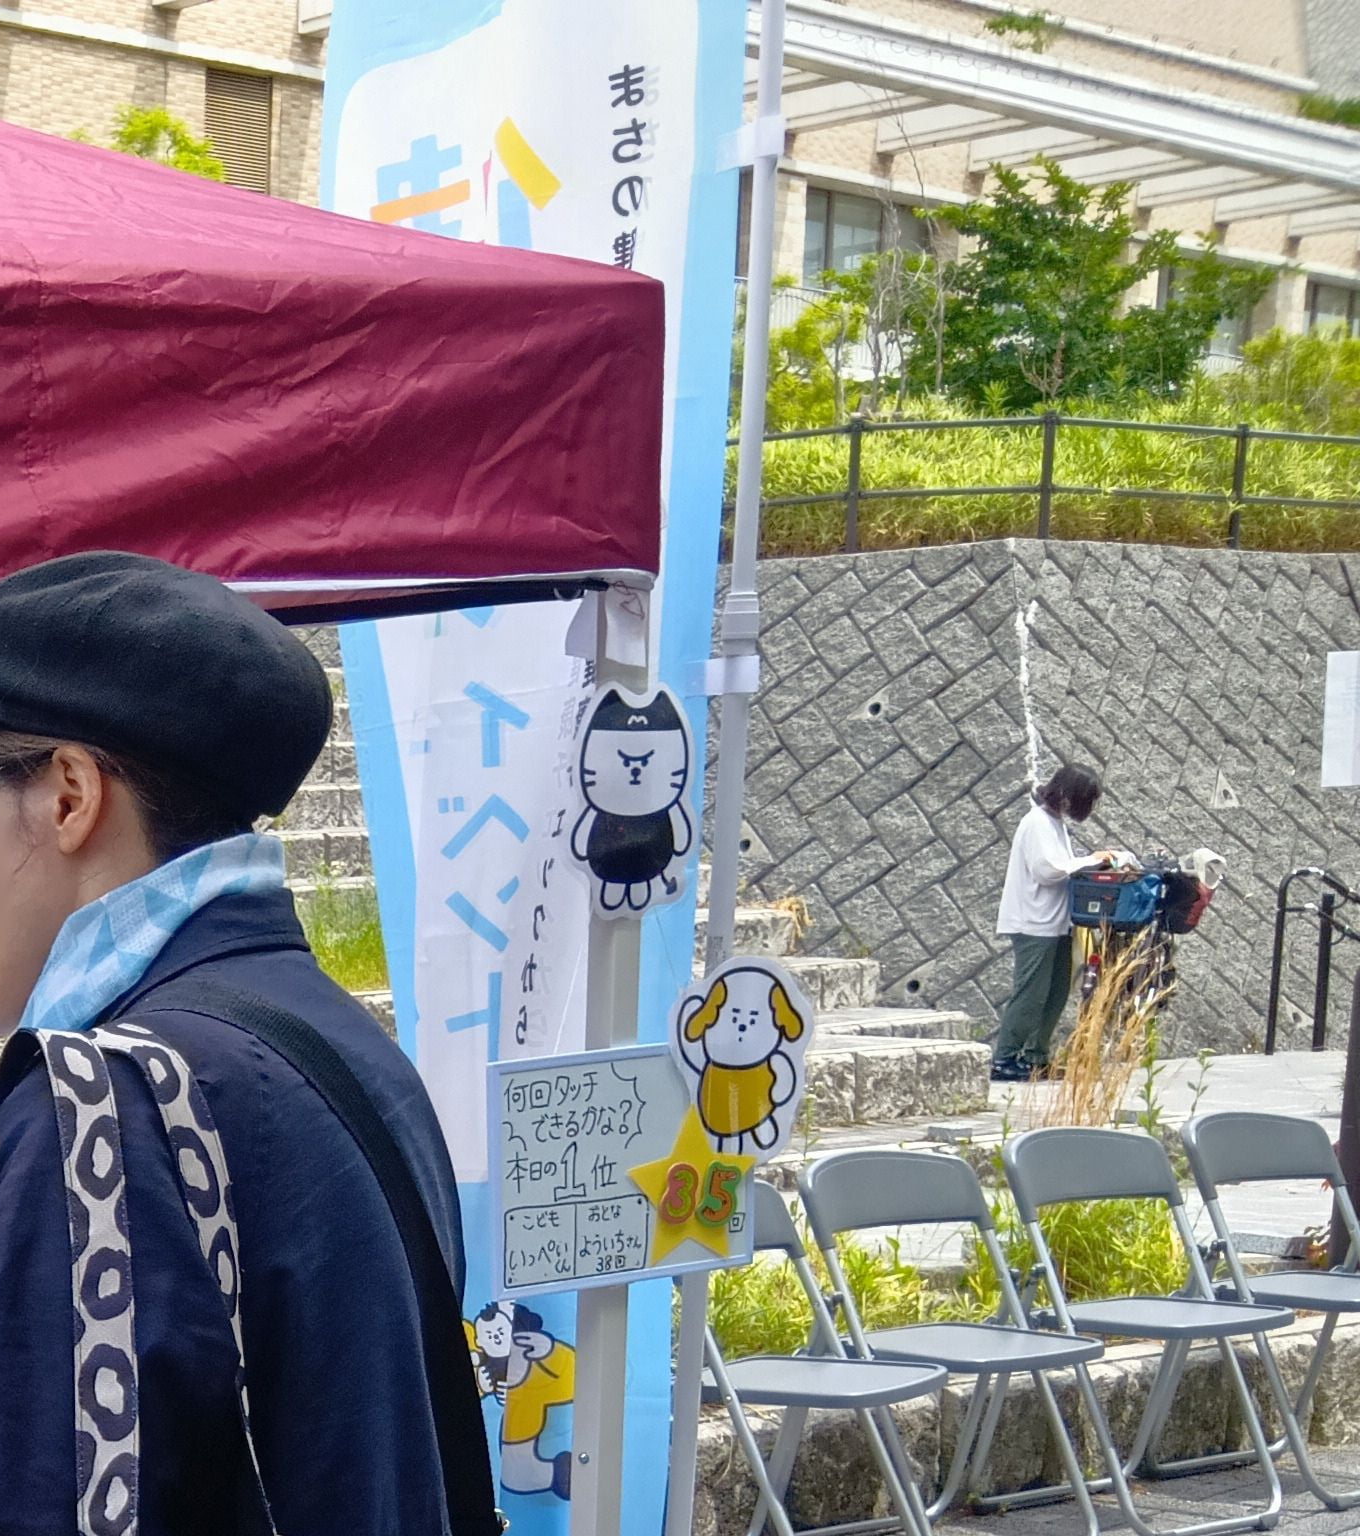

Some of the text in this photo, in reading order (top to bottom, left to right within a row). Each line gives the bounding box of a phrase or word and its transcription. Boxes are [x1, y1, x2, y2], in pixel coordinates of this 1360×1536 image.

[504, 1071, 598, 1113] 何回タッチ
[531, 1099, 633, 1143] できるかな?
[522, 1210, 560, 1231] こども
[588, 1204, 622, 1222] おとな
[595, 1254, 626, 1272] 38回
